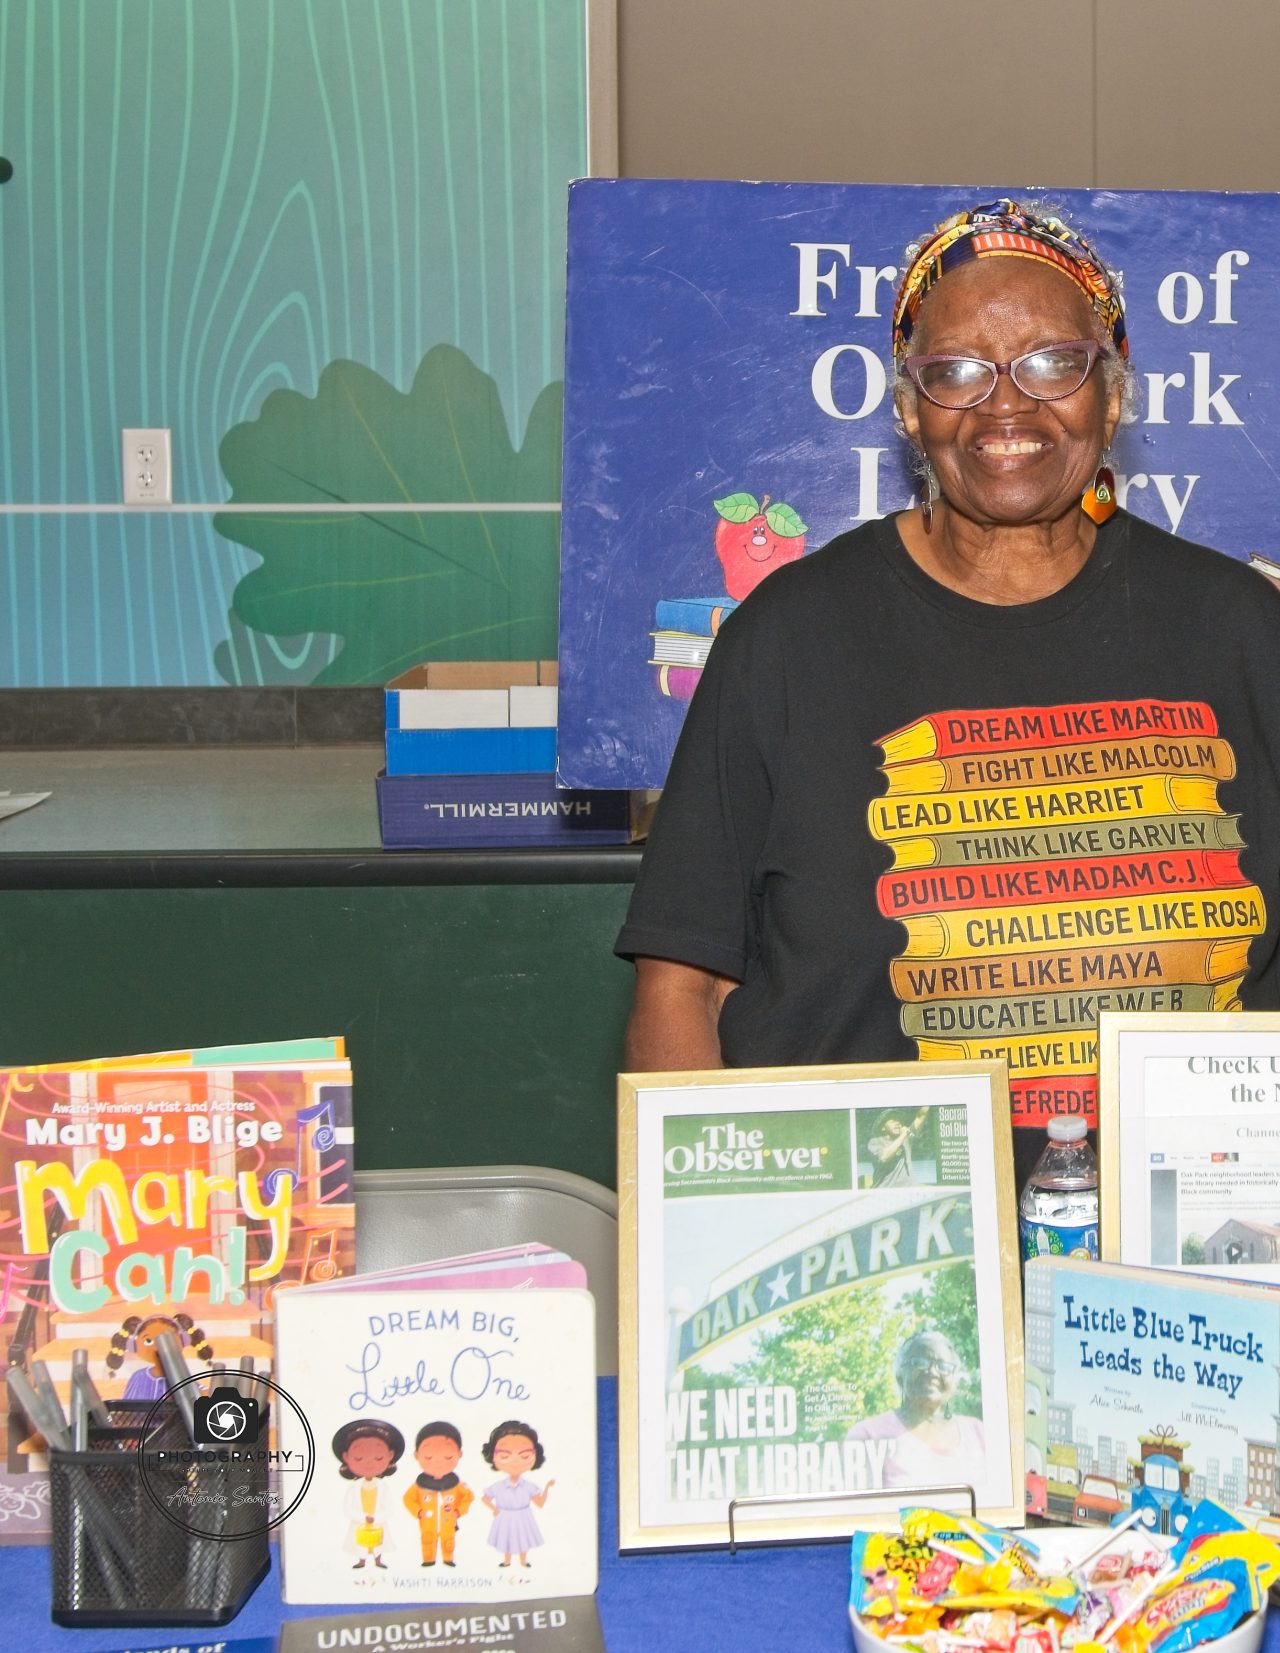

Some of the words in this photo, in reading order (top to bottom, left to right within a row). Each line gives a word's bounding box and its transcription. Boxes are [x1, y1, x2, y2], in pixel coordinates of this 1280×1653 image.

[1156, 250, 1250, 325] of
[947, 714, 1046, 745] DREAM
[1049, 709, 1107, 738] LIKE
[1111, 703, 1205, 732] MARTIN
[962, 757, 1035, 785] FIGHT
[1042, 751, 1097, 779] LIKE
[1101, 743, 1216, 772] MALCOLM
[880, 802, 953, 831] LEAD
[958, 797, 1020, 825] LIKE
[1025, 785, 1145, 820] HARRIET
[956, 834, 1038, 862] THINK
[1044, 830, 1100, 857] LIKE
[1107, 822, 1207, 851] GARVEY
[891, 874, 976, 908] BUILD
[981, 870, 1042, 898] LIKE
[1045, 861, 1154, 893] MADAM
[1158, 858, 1204, 885] C.J.
[966, 906, 1132, 948] CHALLENGE
[1139, 901, 1199, 931] LIKE
[1202, 899, 1261, 929] ROSA
[907, 964, 1005, 996] WRITE
[1010, 959, 1074, 986] LIKE
[1081, 951, 1163, 982] MAYA
[922, 1002, 1048, 1032] EDUCATE
[1053, 994, 1111, 1027] LIKE
[1187, 1056, 1261, 1075] Check
[51, 1101, 143, 1115] Award-Winning
[146, 1100, 181, 1113] Artist
[184, 1100, 208, 1112] and
[210, 1100, 256, 1112] Actress
[1025, 1089, 1097, 1115] FREDE
[1231, 1083, 1266, 1103] the
[25, 1118, 126, 1152] Mary
[139, 1115, 176, 1147] J.
[187, 1114, 283, 1148] Blige
[702, 1122, 764, 1151] The
[664, 1141, 829, 1175] Observer
[1209, 1171, 1252, 1179] neighborhood
[15, 1159, 293, 1281] Mary
[50, 1226, 247, 1315] Can!
[692, 1276, 761, 1348] OAK
[801, 1200, 958, 1295] PARK
[369, 1309, 461, 1337] DREAM
[472, 1311, 521, 1343] BIG,
[1062, 1295, 1127, 1333] Little
[1132, 1306, 1185, 1343] Blue
[1189, 1313, 1264, 1363] Truck
[346, 1342, 445, 1411] Little
[450, 1346, 531, 1402] One
[1080, 1341, 1142, 1376] Leads
[1153, 1353, 1186, 1384] the
[1194, 1361, 1244, 1400] Way
[665, 1390, 709, 1444] WE
[713, 1386, 798, 1440] NEED
[391, 1576, 432, 1588] VASHTI
[436, 1575, 493, 1588] HARRISON
[317, 1609, 568, 1650] UNDOCUMENTED
